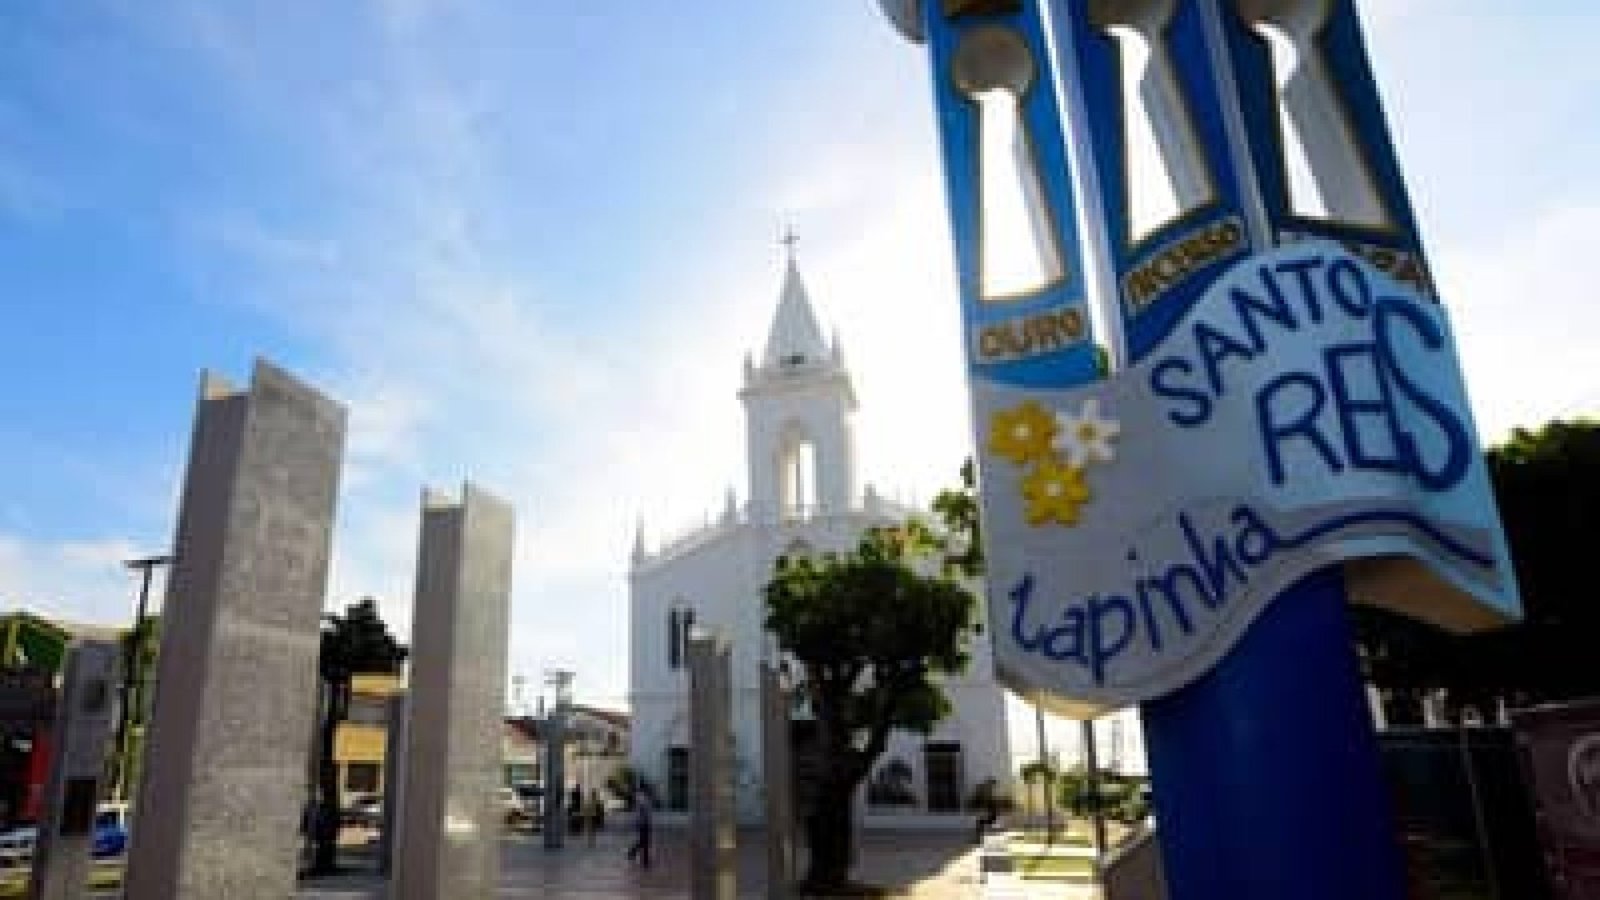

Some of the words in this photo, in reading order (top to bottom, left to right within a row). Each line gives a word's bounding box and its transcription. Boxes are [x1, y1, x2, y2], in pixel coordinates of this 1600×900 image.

[979, 307, 1083, 359] OURO
[1150, 254, 1373, 427] SANTO
[1255, 295, 1472, 492] REIS
[1007, 503, 1280, 689] Lapinha
